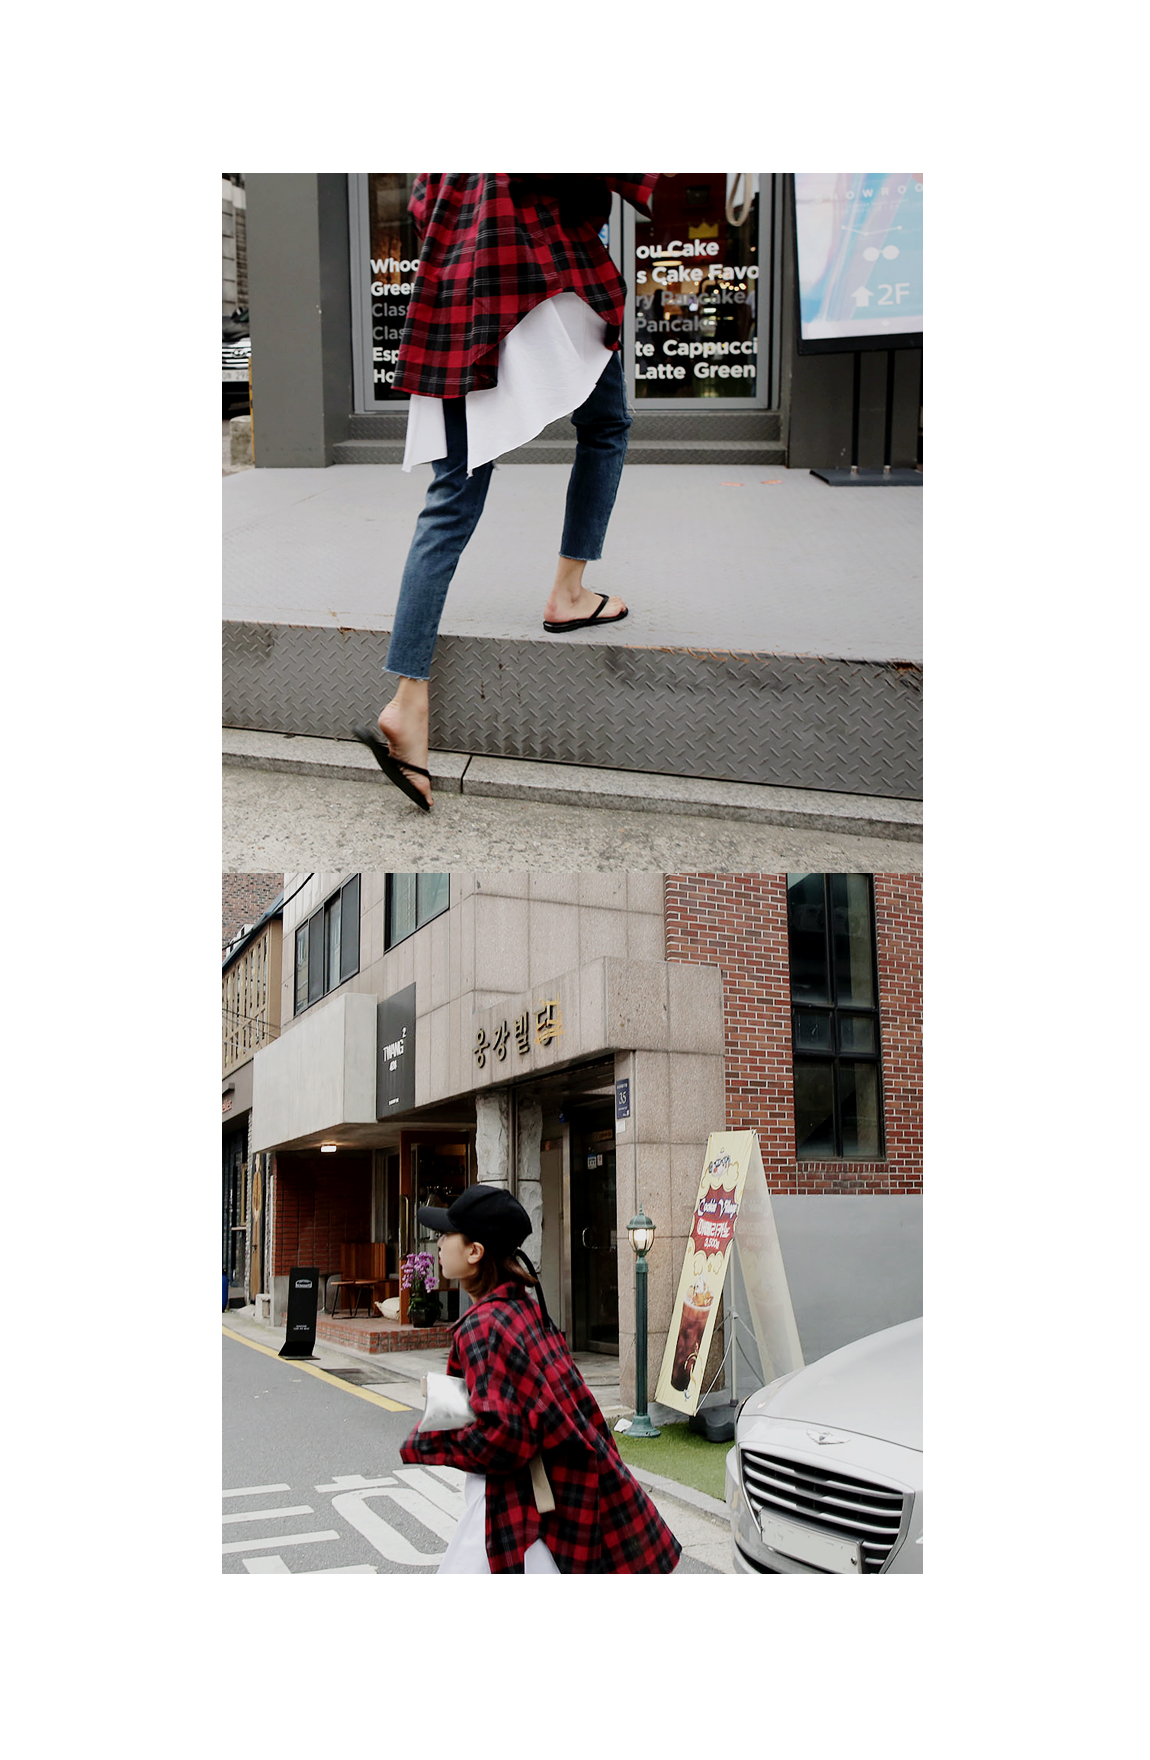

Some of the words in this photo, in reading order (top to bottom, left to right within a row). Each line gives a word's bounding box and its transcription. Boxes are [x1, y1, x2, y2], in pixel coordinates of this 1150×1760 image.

[667, 239, 719, 257] Cake
[652, 265, 703, 283] Cake
[709, 264, 759, 281] Favo
[661, 290, 747, 306] Pancake
[877, 282, 910, 306] 2F
[372, 302, 409, 317] Clas
[663, 337, 758, 358] Cappucci
[635, 363, 686, 379] Latte
[694, 361, 757, 379] Green
